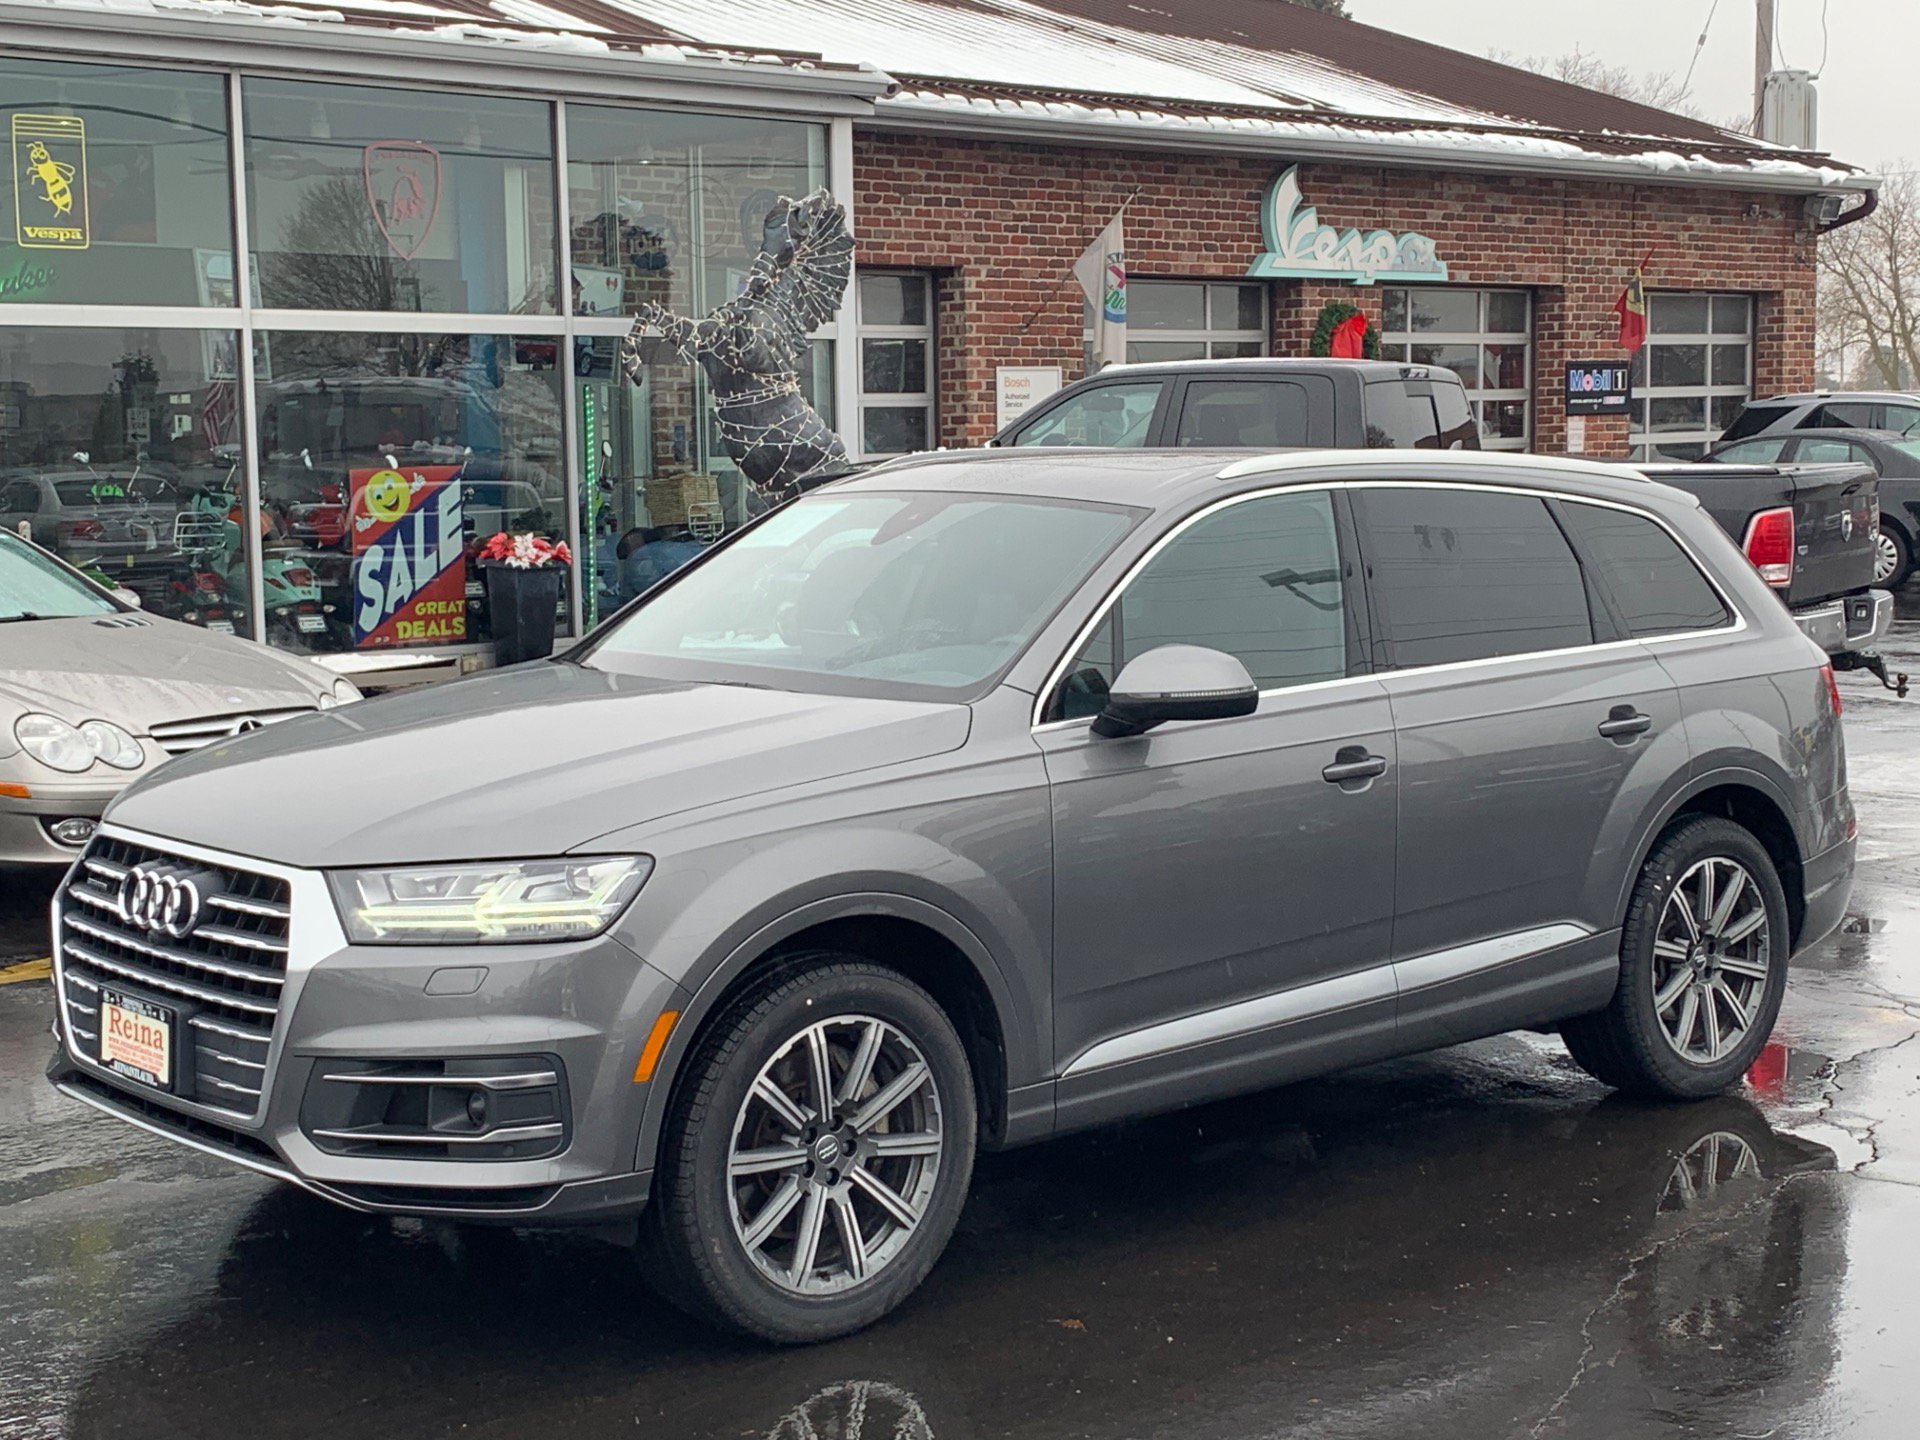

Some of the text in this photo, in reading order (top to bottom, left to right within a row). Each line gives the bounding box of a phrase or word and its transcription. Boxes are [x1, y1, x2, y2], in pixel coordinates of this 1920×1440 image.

[23, 226, 83, 242] Vespa
[1262, 164, 1444, 282] Vespa
[1004, 376, 1030, 388] Bosch
[1570, 369, 1611, 392] Mobil
[358, 478, 464, 633] SALE
[415, 600, 465, 615] GREAT
[396, 616, 466, 639] DEALS
[109, 1006, 164, 1051] Reina
